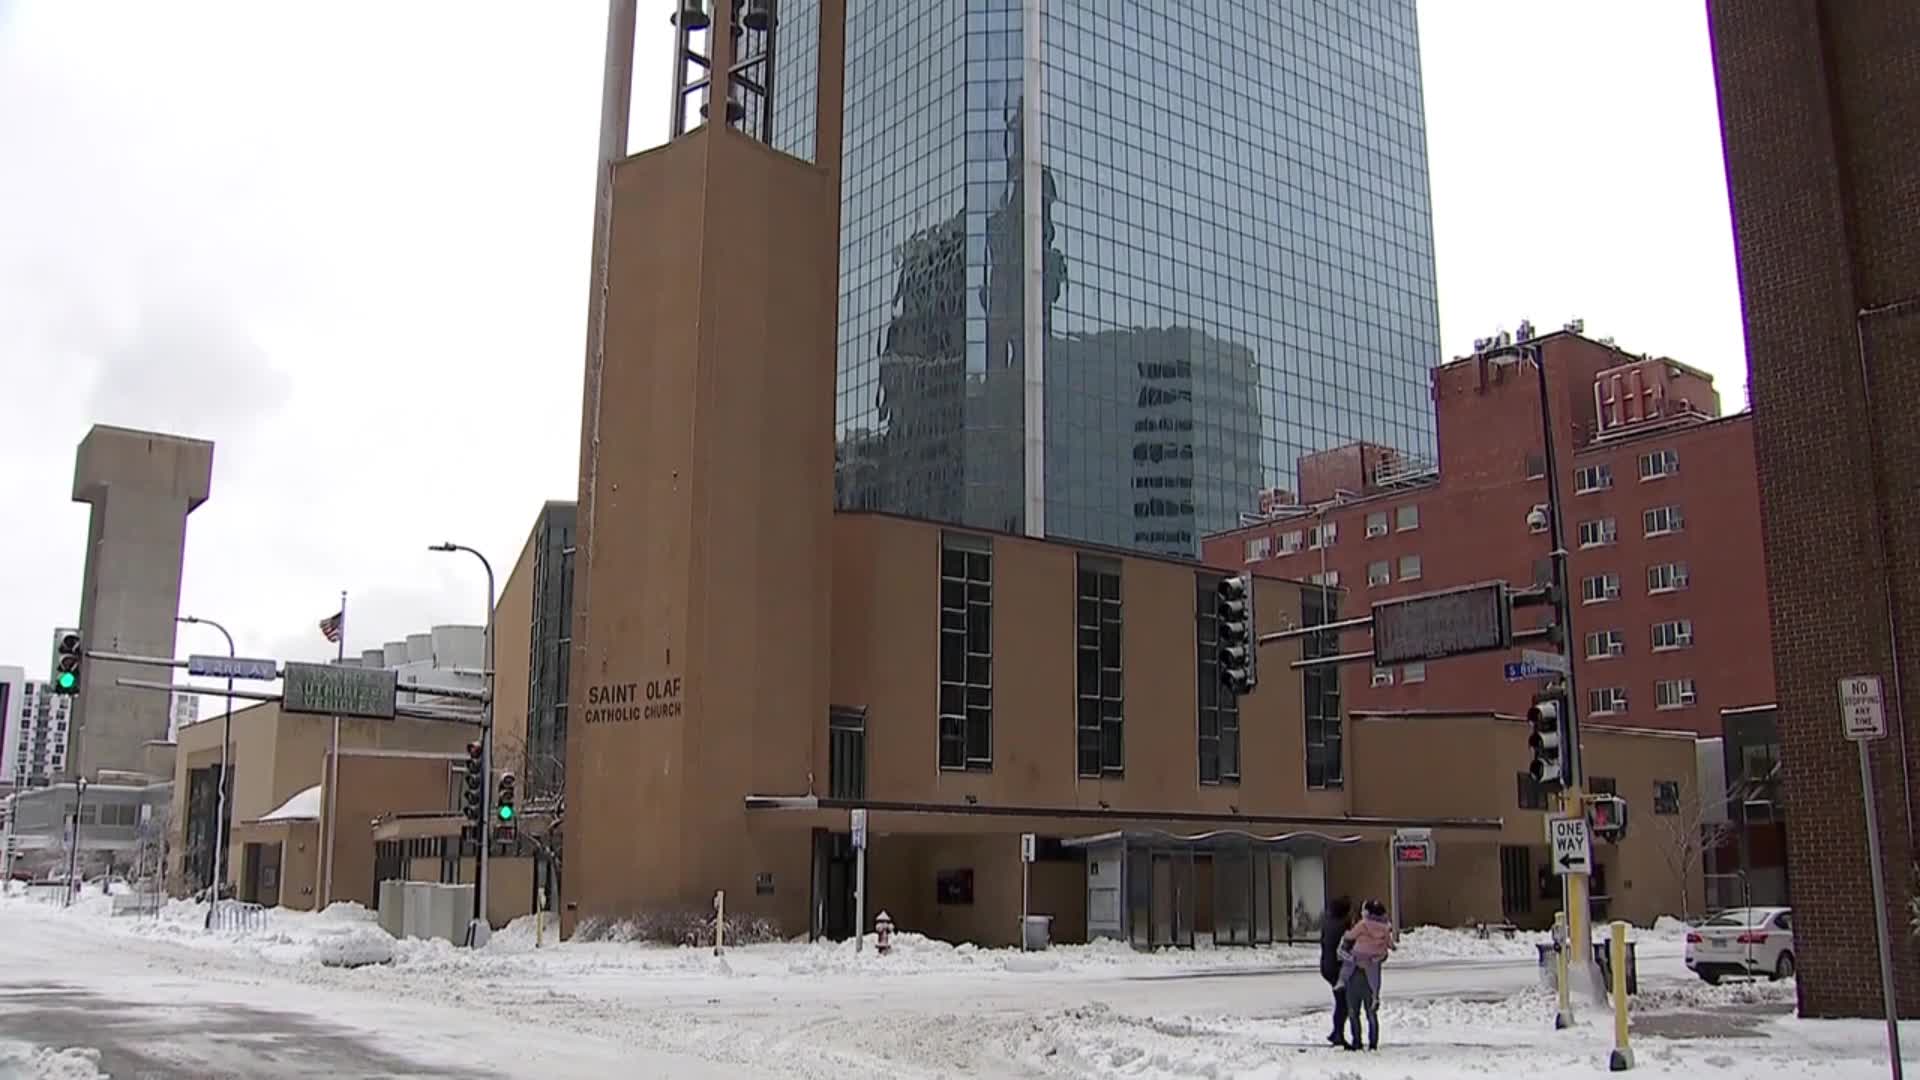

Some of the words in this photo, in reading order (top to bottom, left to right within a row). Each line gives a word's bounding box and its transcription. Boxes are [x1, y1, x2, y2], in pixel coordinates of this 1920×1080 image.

[1509, 664, 1516, 677] S
[588, 683, 638, 704] SAINT
[646, 677, 681, 700] OLAF
[1851, 681, 1868, 695] NO
[585, 707, 640, 724] CATHOLIC
[644, 702, 682, 720] CHURCH
[1855, 706, 1871, 715] ANY
[1855, 716, 1872, 725] TIME
[1557, 822, 1584, 837] ONE
[1556, 837, 1585, 851] WAY
